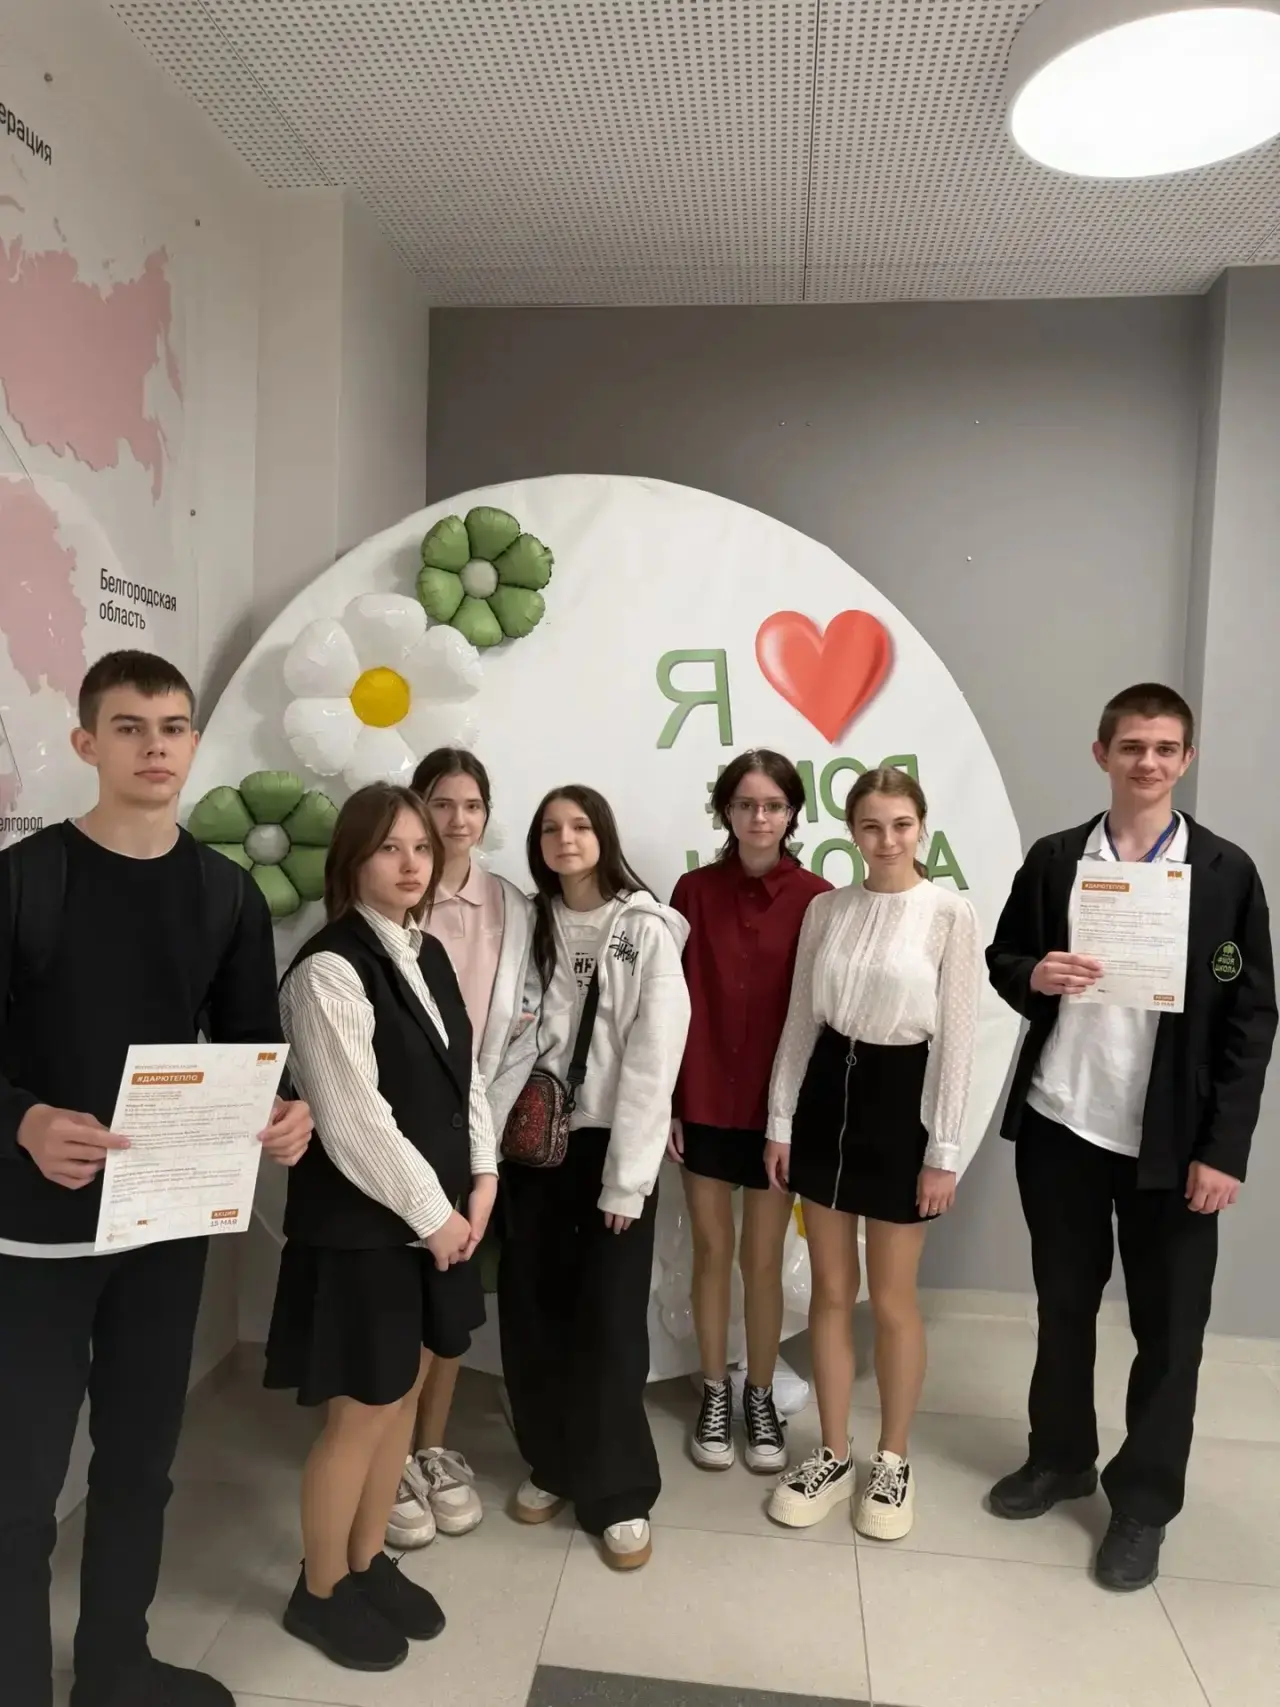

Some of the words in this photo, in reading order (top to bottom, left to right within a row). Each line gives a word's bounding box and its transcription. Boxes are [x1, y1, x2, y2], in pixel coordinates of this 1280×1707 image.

[100, 567, 177, 612] Белгородская
[99, 600, 146, 630] область
[655, 648, 734, 749] Я
[135, 1073, 199, 1084] #ДАРЮТЕПЛО
